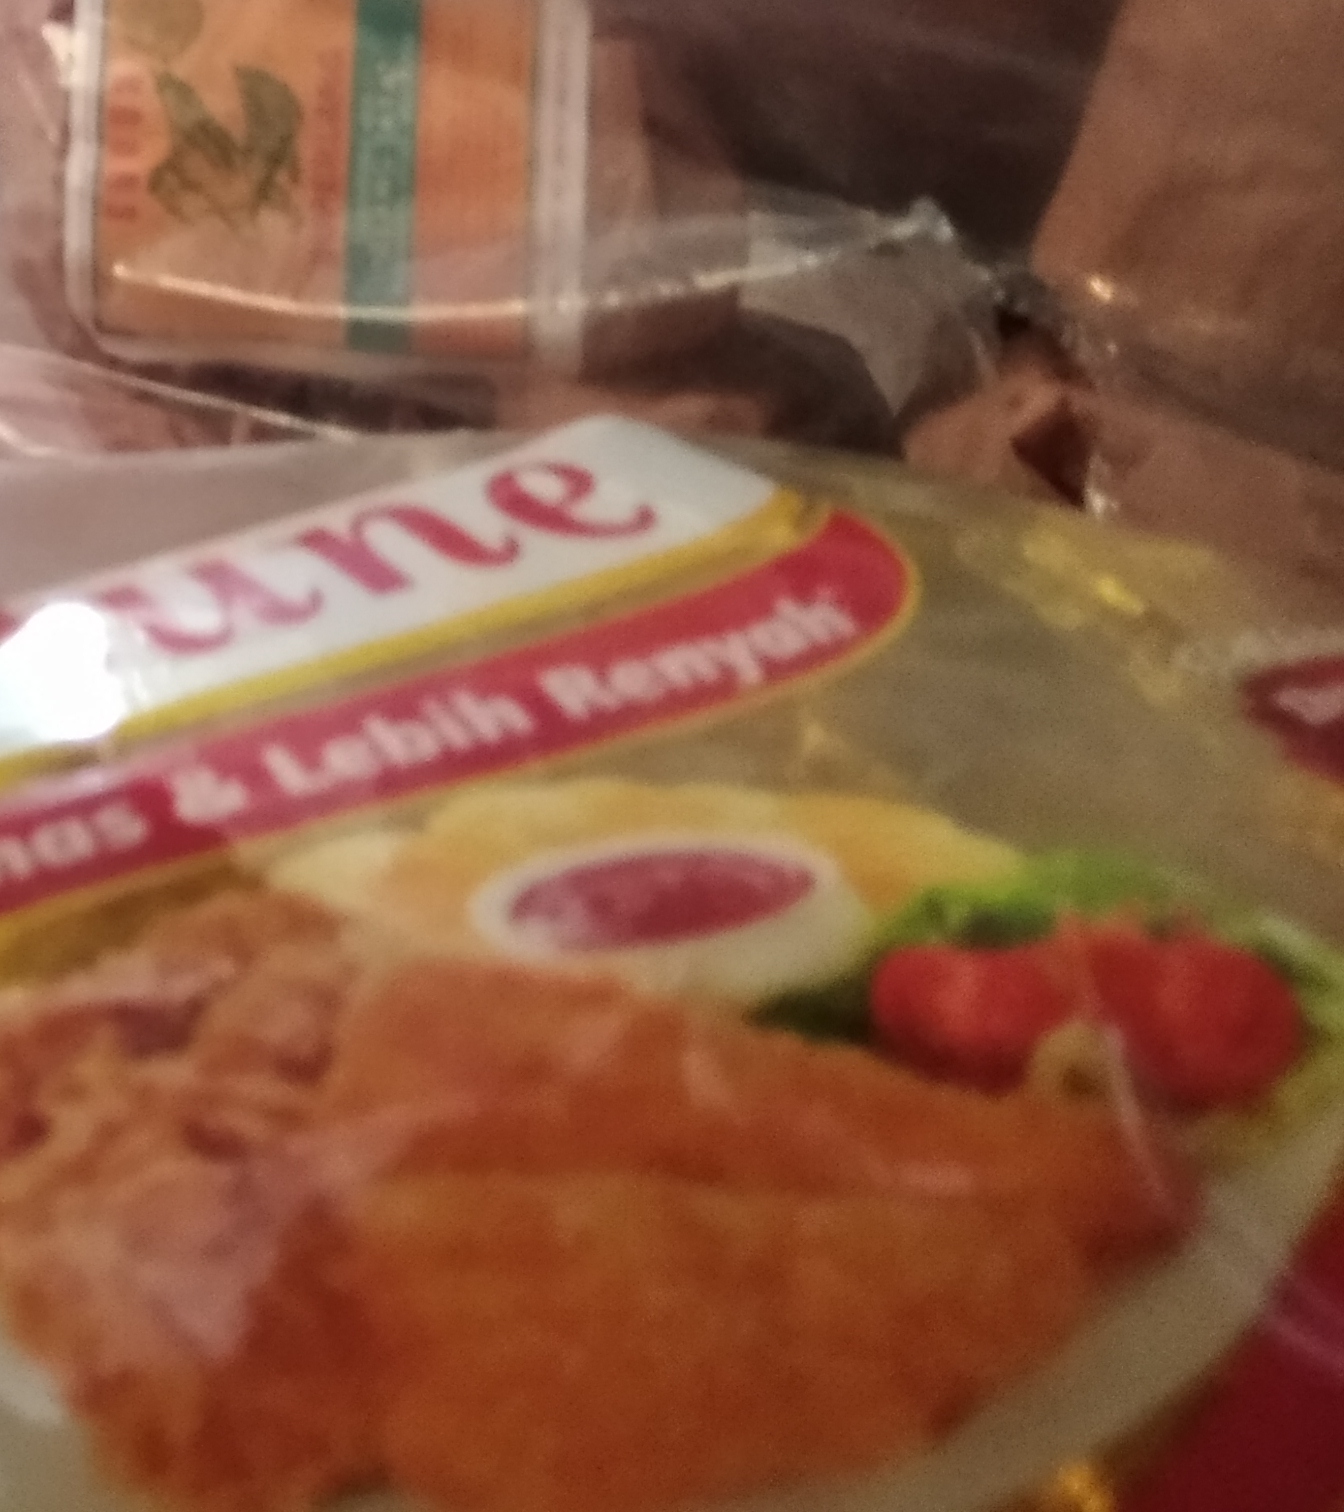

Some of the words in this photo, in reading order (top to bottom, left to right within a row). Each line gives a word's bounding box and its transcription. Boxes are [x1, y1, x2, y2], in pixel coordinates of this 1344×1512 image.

[172, 765, 248, 826] &
[262, 691, 535, 797] Lebih
[538, 586, 858, 722] Renyah
